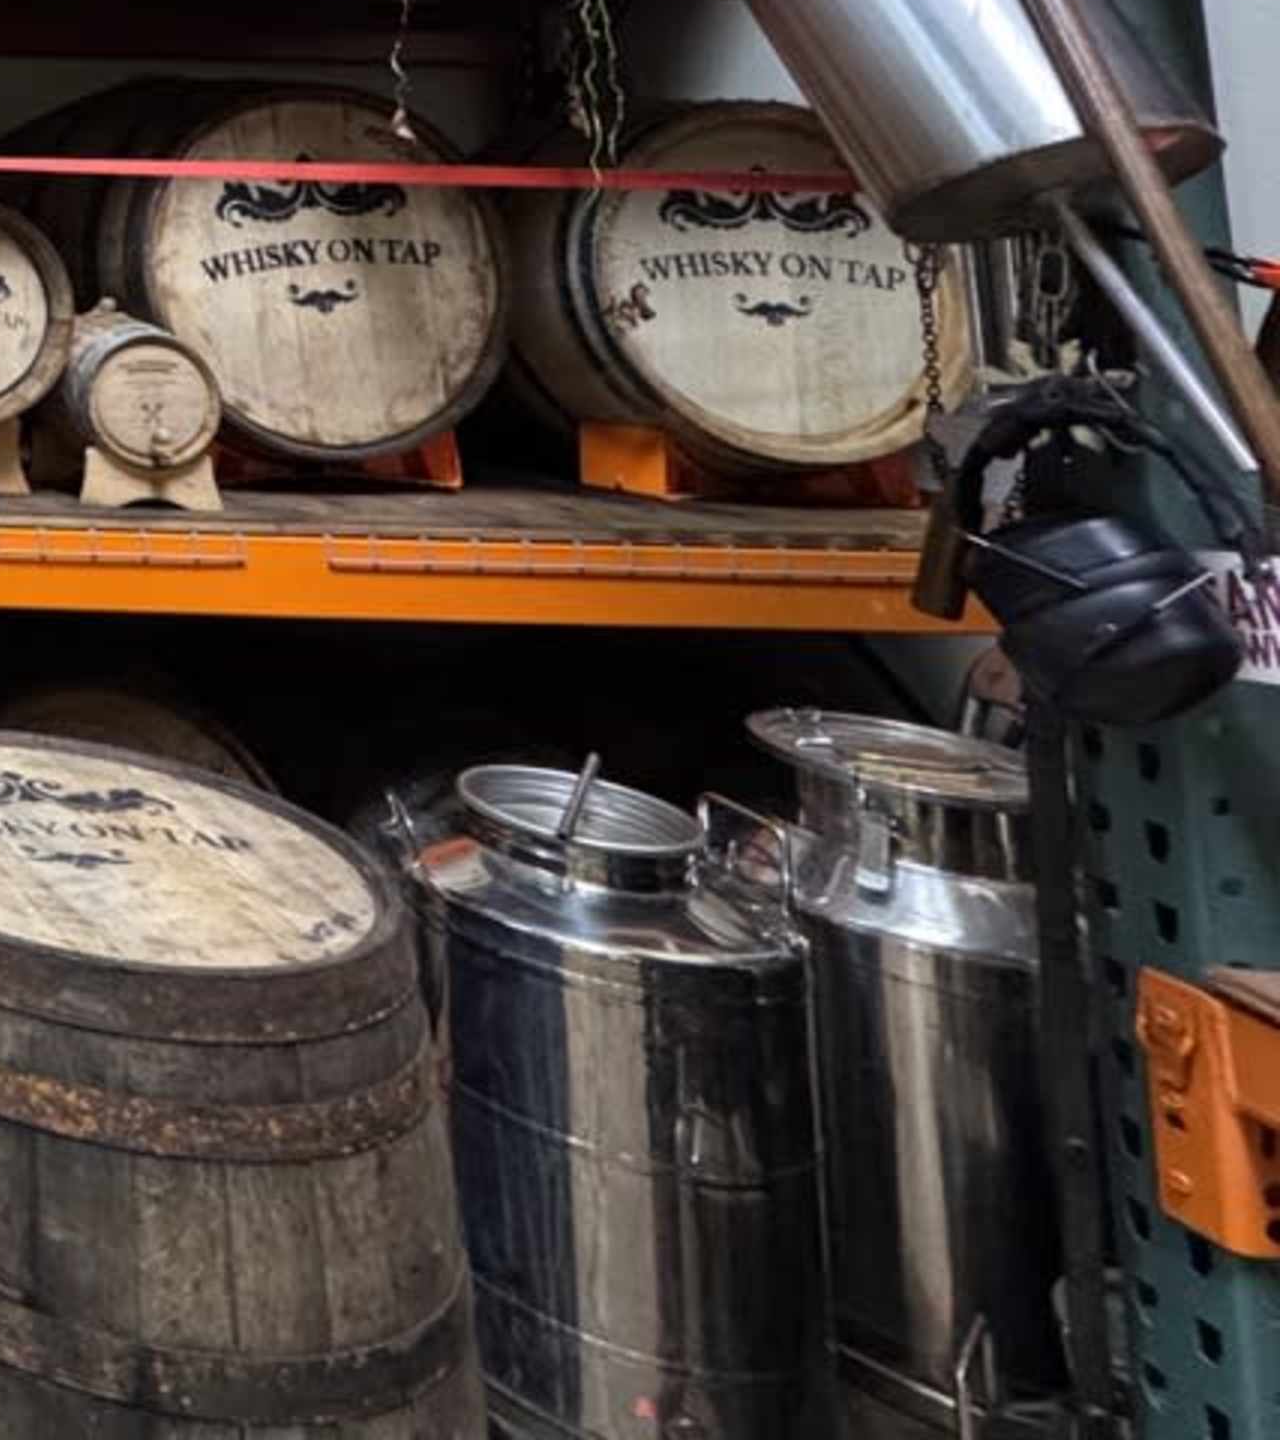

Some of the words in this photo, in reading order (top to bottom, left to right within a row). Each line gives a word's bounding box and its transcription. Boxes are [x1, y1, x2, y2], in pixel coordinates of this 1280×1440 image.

[200, 239, 325, 284] WHISKY
[327, 237, 374, 265] ON
[378, 239, 442, 270] TAP
[639, 250, 775, 282] WHISKY
[779, 251, 832, 282] ON
[841, 261, 907, 292] TAP
[69, 822, 147, 842] ON
[151, 827, 252, 852] TAP
